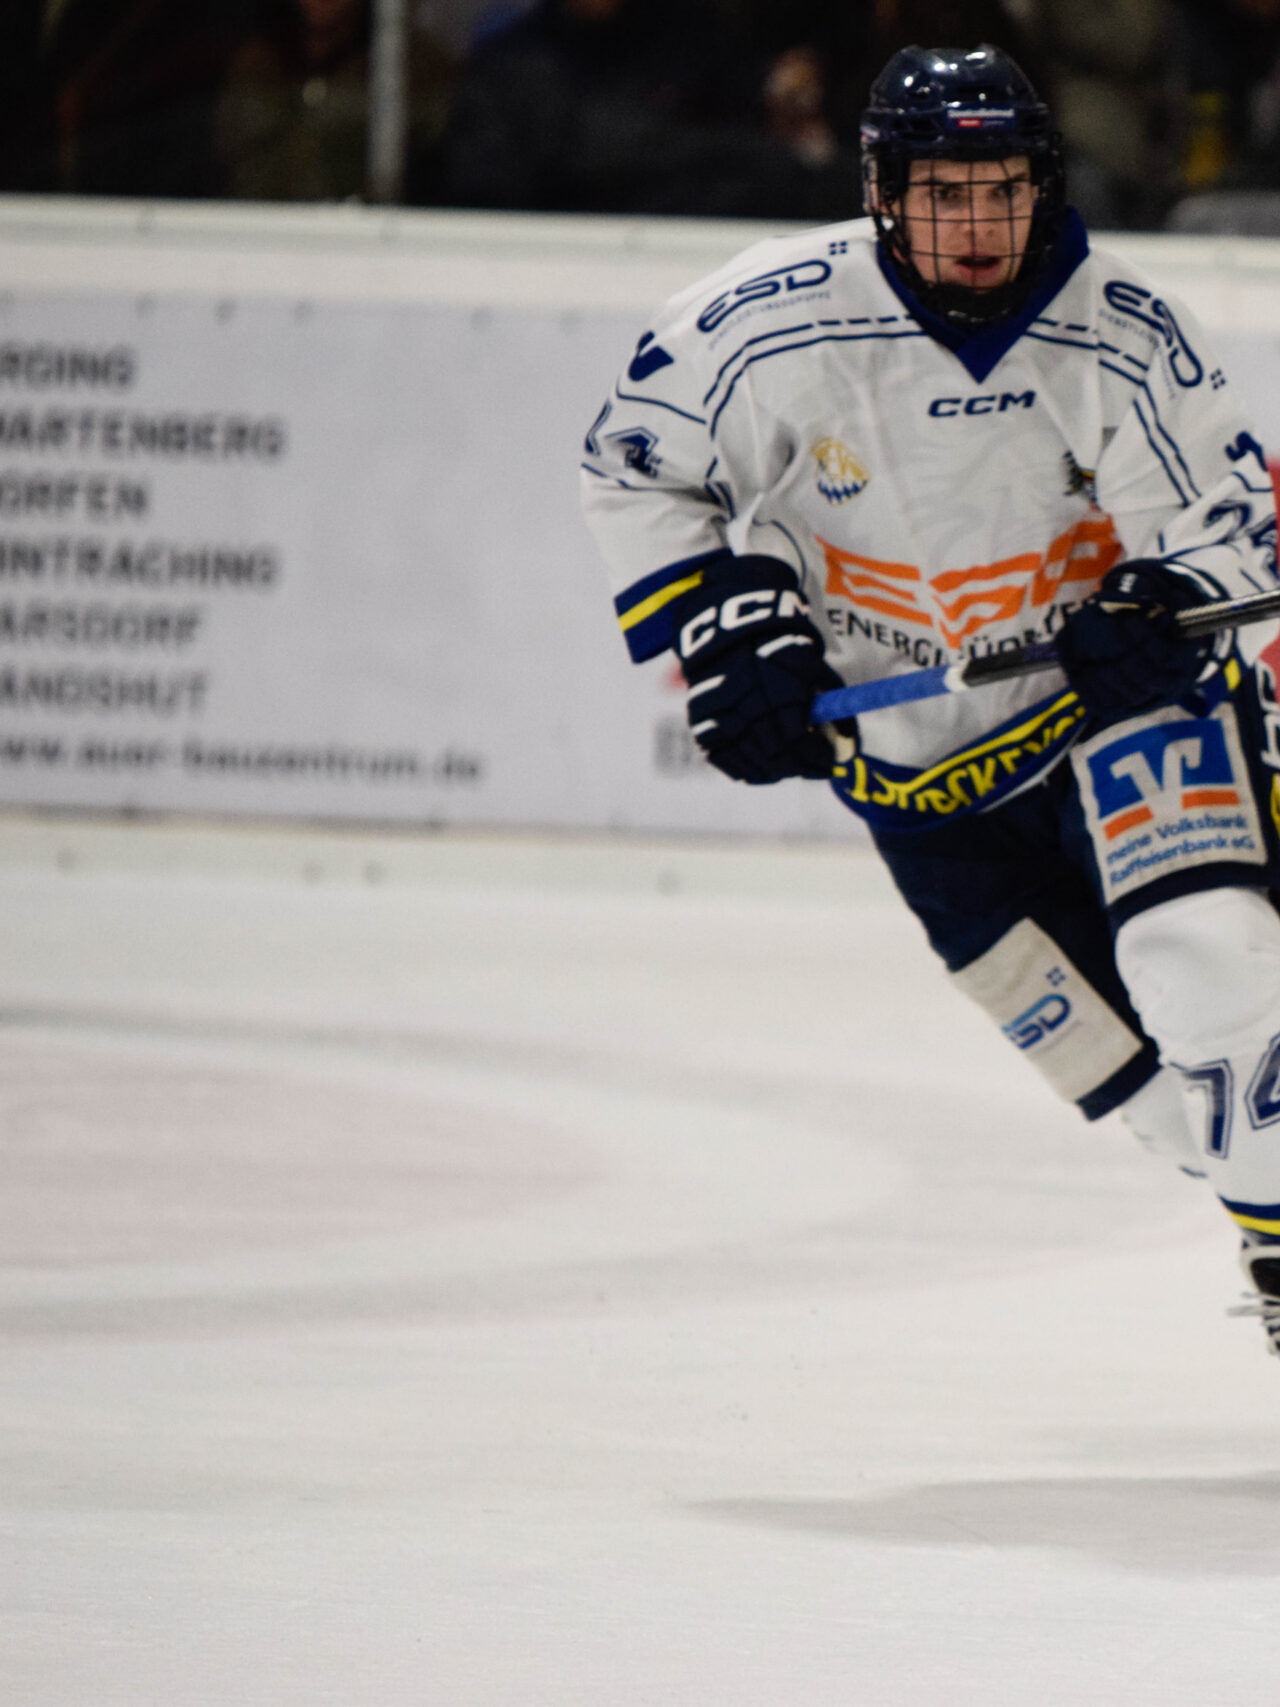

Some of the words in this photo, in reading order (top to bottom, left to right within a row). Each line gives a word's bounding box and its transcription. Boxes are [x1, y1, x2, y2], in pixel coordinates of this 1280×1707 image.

[928, 391, 1036, 417] CCM
[827, 608, 945, 668] ENERGI
[1155, 813, 1248, 839] Volksbank
